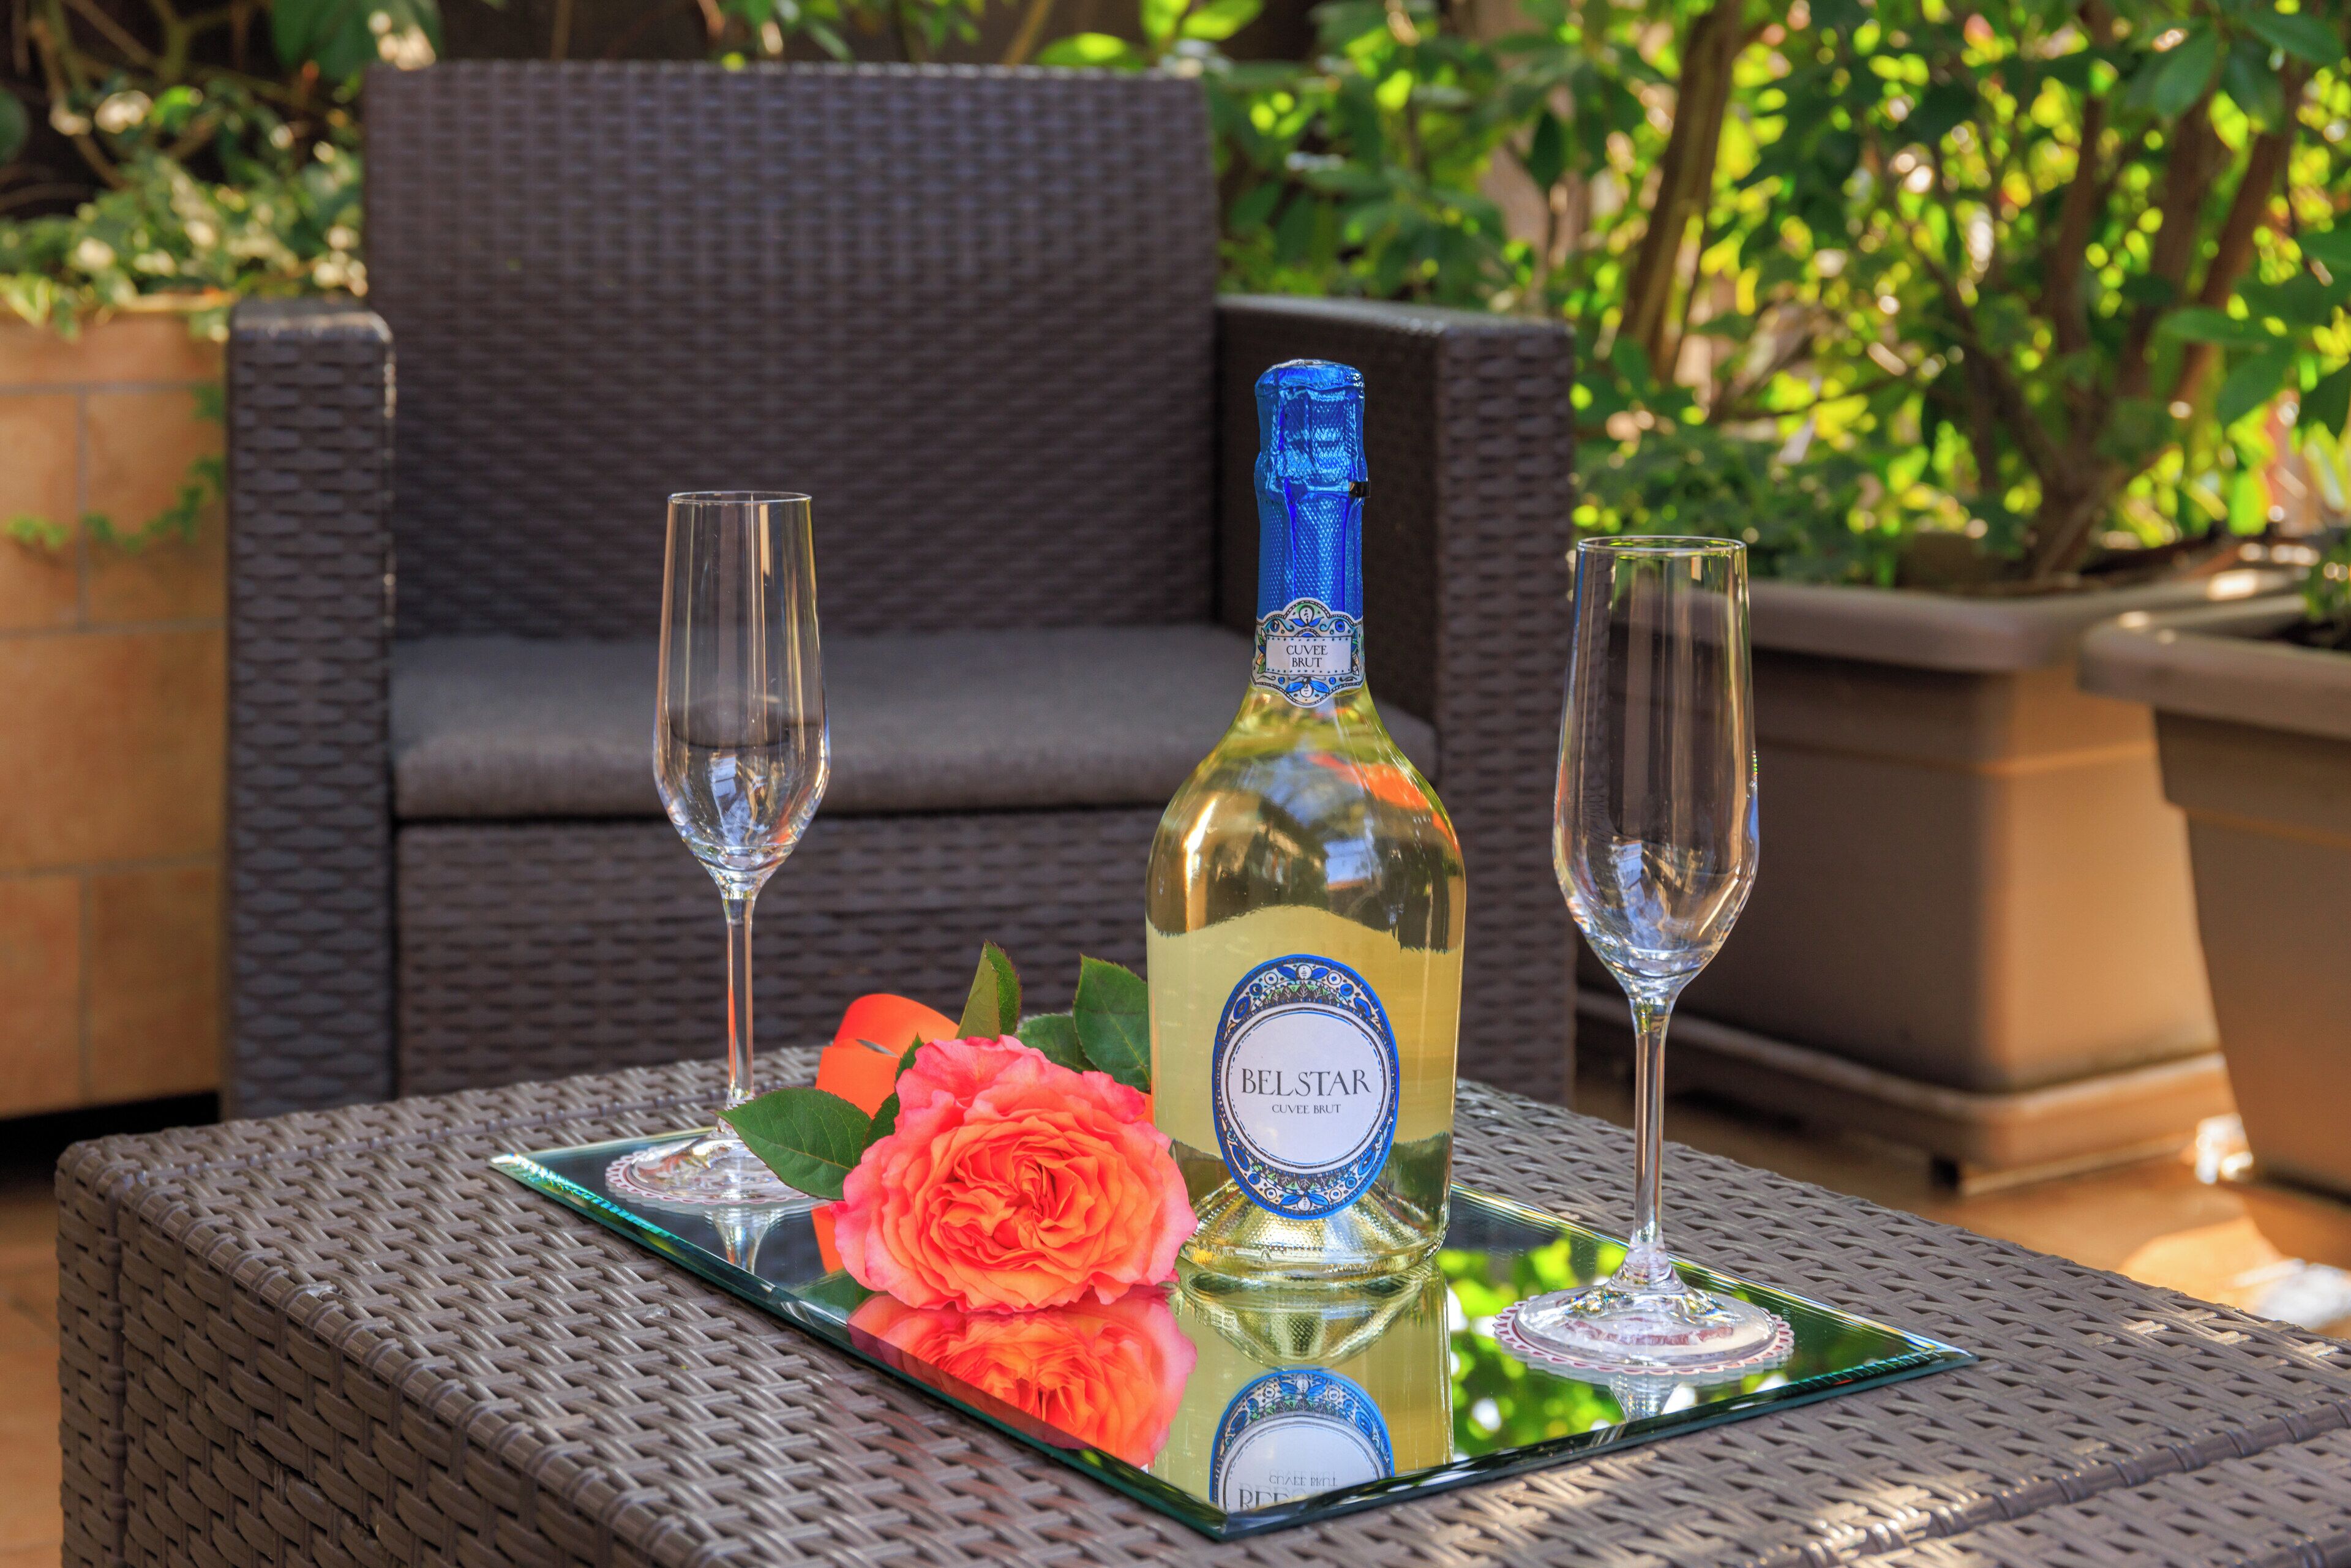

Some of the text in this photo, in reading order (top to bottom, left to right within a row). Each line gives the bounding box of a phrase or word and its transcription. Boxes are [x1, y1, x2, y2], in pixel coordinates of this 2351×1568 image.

[1286, 645, 1328, 655] CUVEE
[1292, 657, 1322, 667] BRUT
[1242, 1068, 1371, 1097] BELSTAR
[1272, 1104, 1341, 1114] CUVEE BRUT
